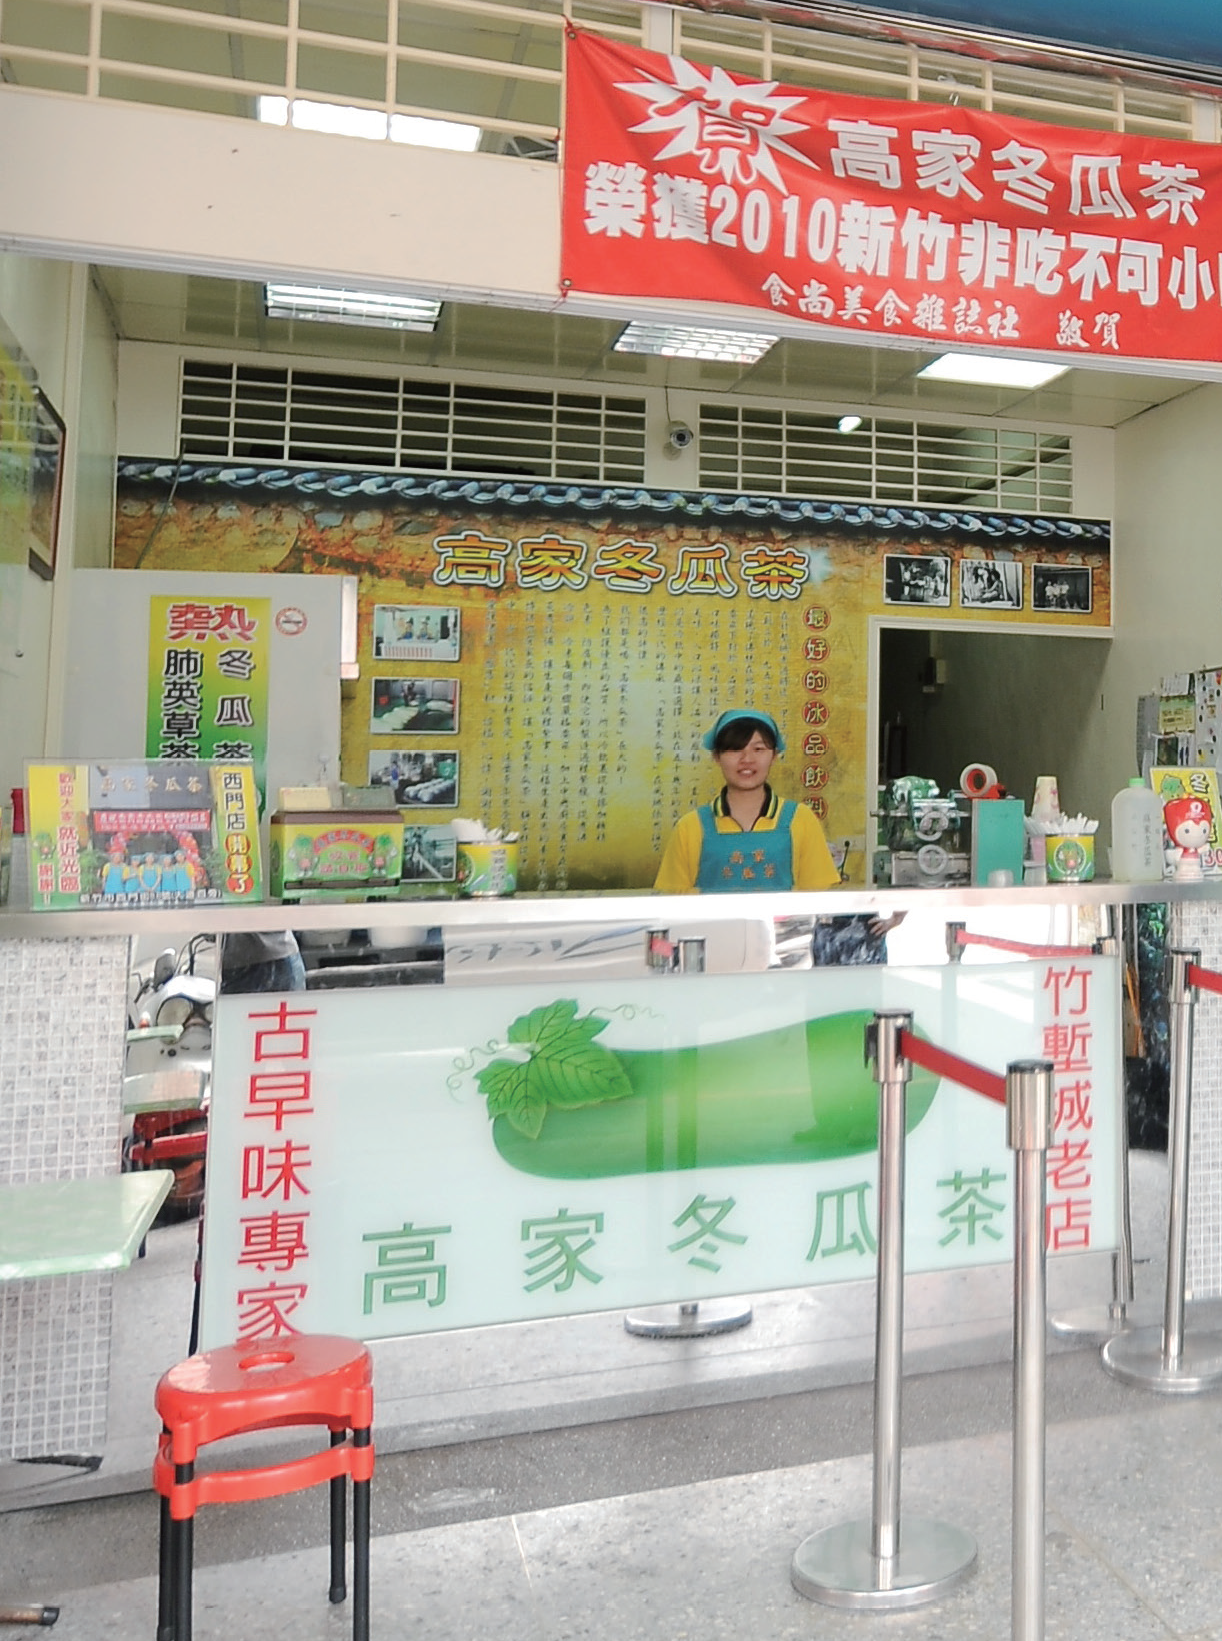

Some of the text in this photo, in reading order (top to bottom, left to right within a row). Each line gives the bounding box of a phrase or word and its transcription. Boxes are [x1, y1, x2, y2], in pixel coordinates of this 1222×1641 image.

[828, 117, 1206, 225] 高家冬瓜茶
[761, 272, 1121, 350] 食尚美食雜誌社 敬賀
[433, 530, 810, 600] 高家冬瓜茶
[167, 604, 256, 641] 熱
[234, 1001, 318, 1341] 古早味專家
[362, 1169, 1008, 1315] 高家冬瓜茶
